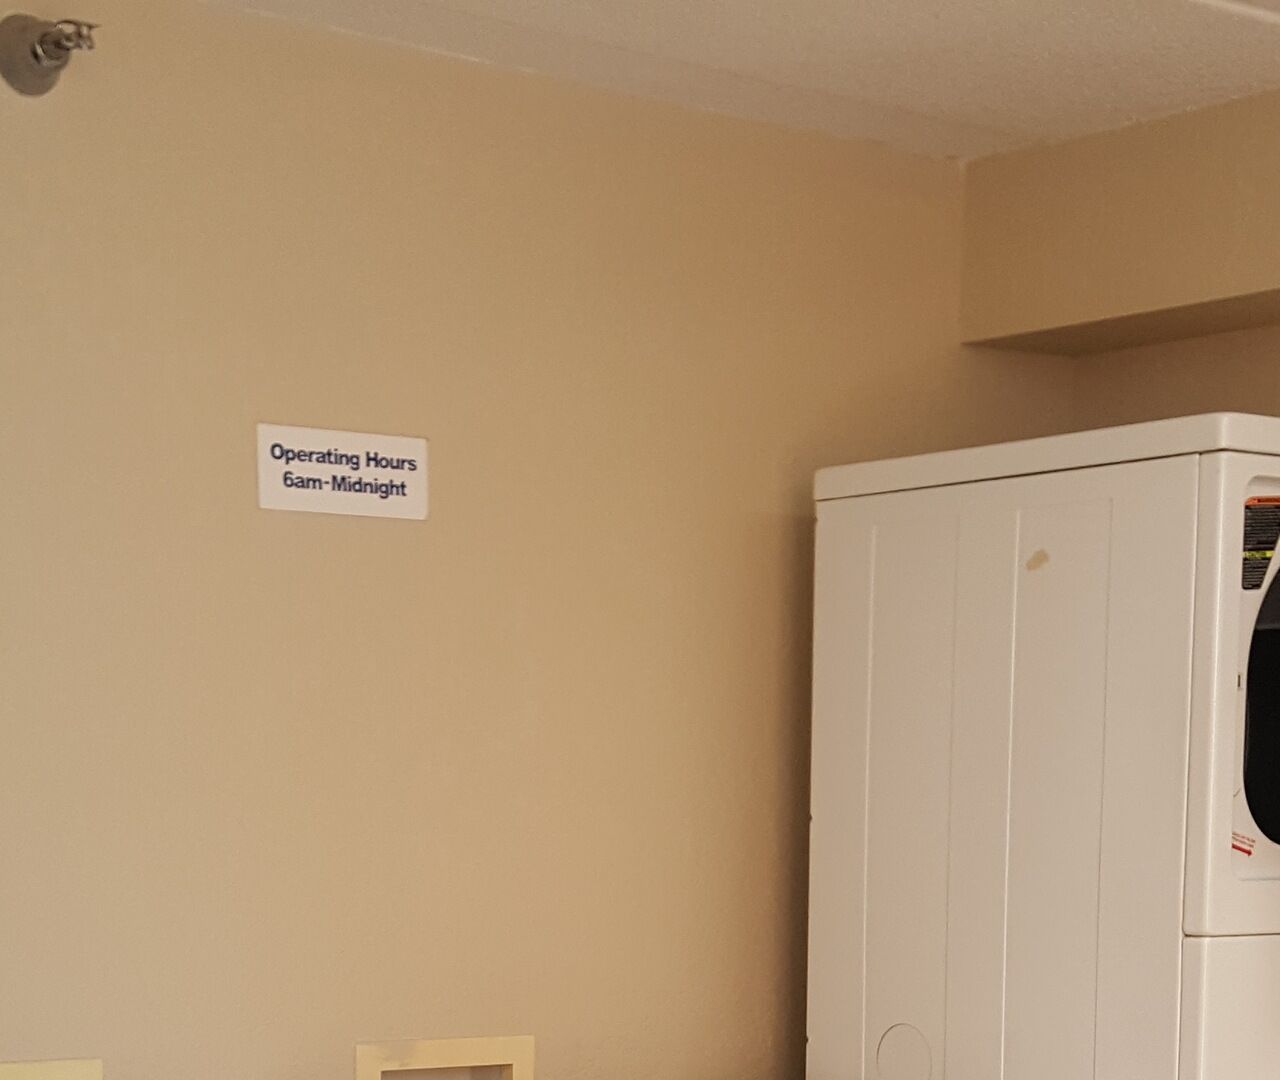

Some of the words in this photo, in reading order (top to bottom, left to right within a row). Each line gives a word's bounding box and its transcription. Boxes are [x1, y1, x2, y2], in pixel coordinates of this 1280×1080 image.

[270, 443, 360, 470] Operating
[366, 451, 417, 471] Hours
[283, 471, 407, 499] 6am-Midnight
